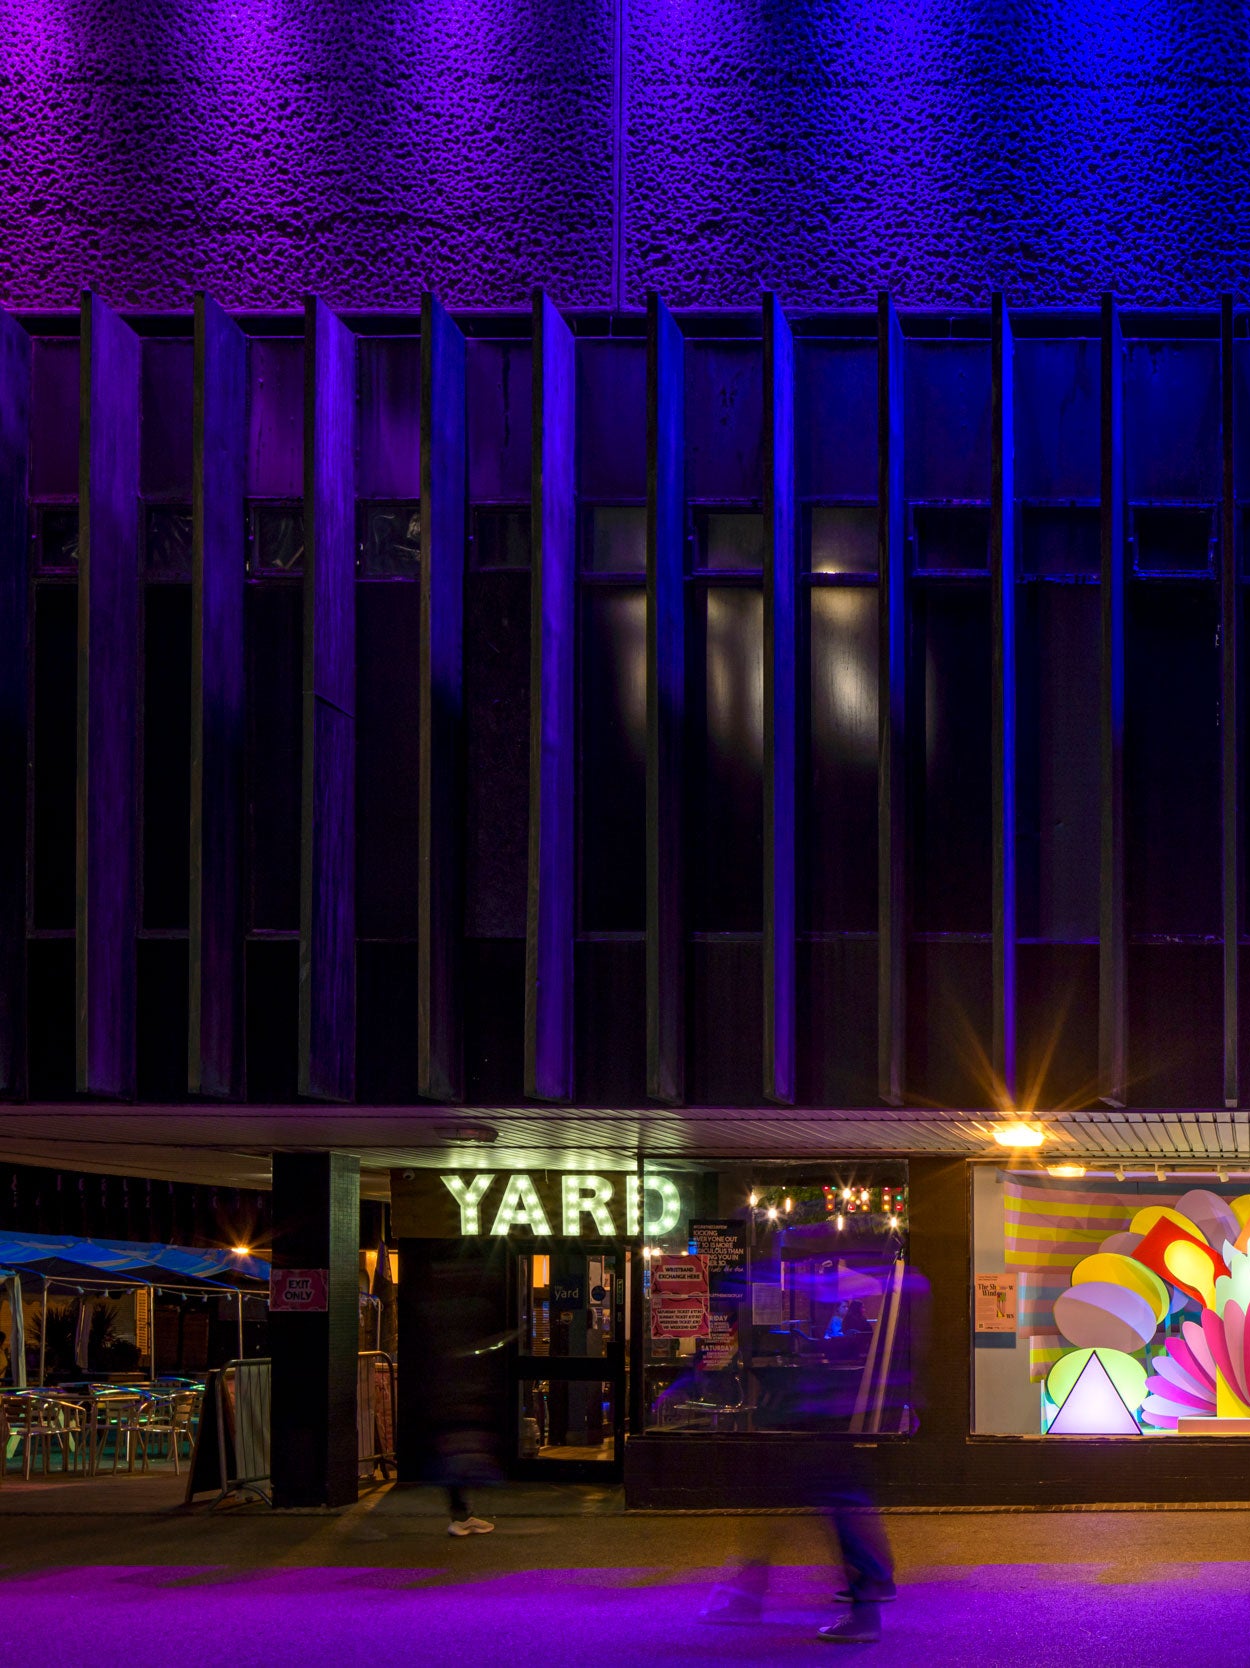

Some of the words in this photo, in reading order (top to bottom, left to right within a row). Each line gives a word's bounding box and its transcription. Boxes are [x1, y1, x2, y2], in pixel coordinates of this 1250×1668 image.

[439, 1174, 681, 1236] YARD
[289, 1280, 310, 1289] EXIT
[284, 1291, 312, 1300] ONLY
[554, 1288, 579, 1300] yard
